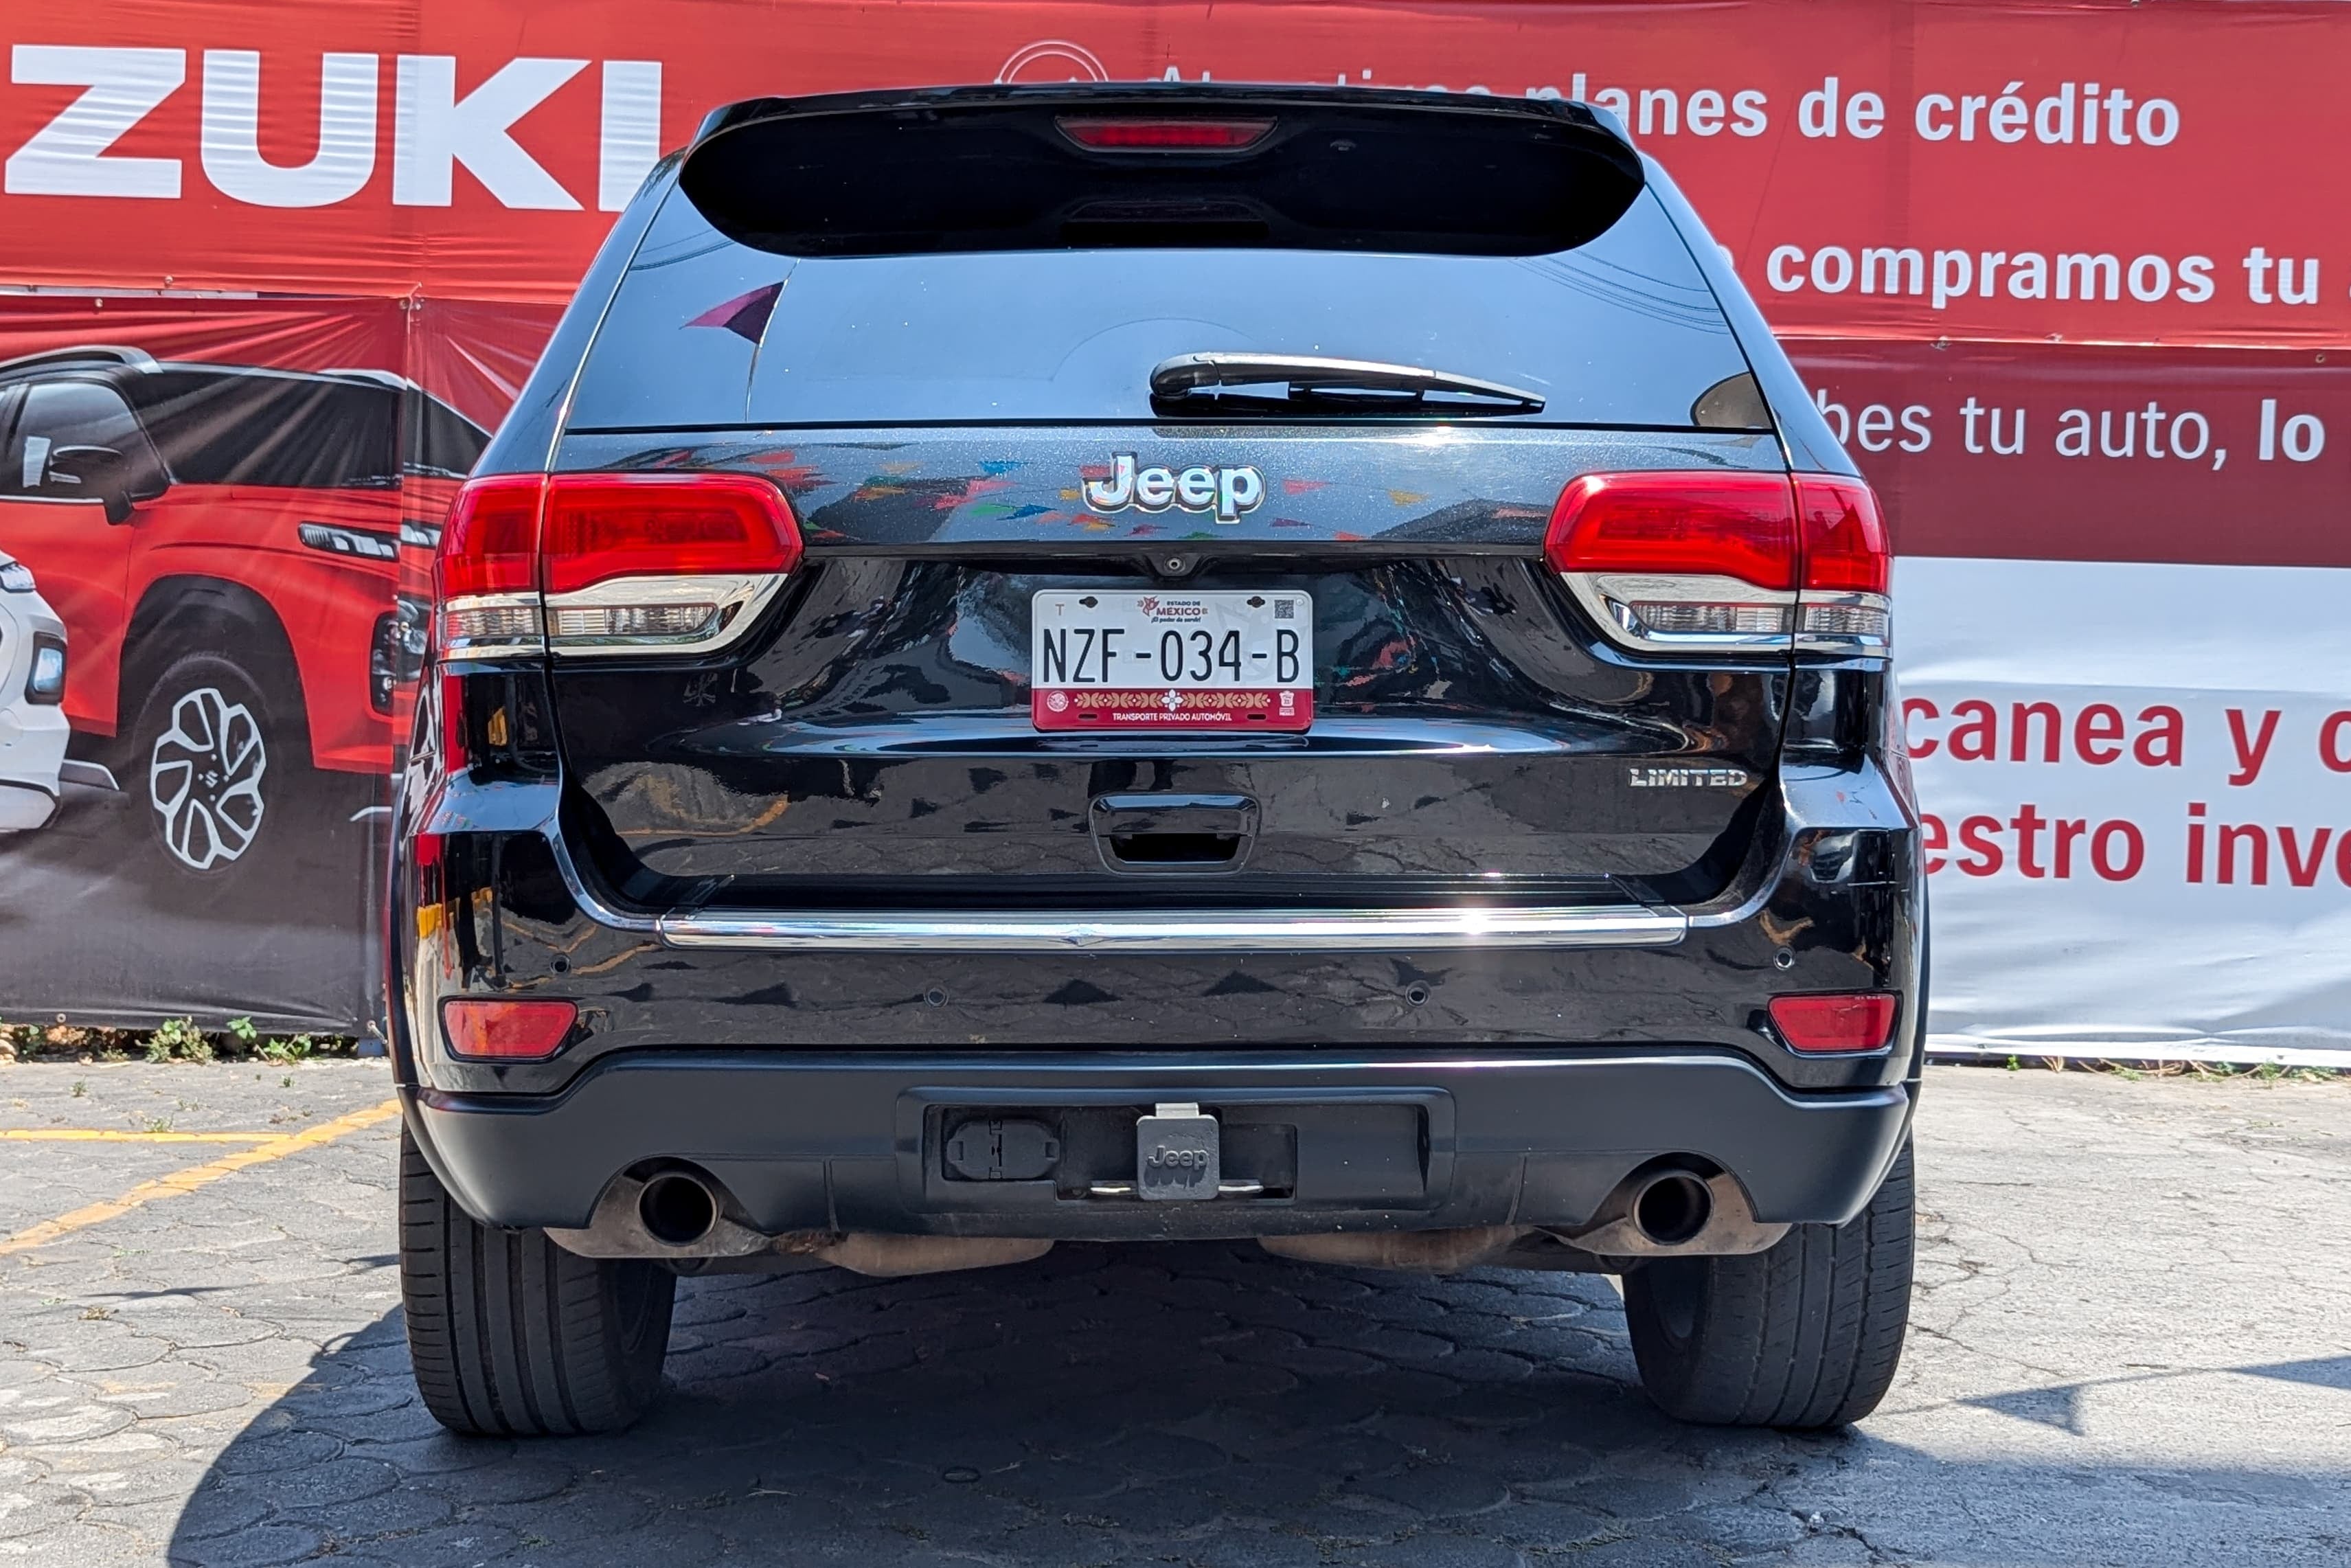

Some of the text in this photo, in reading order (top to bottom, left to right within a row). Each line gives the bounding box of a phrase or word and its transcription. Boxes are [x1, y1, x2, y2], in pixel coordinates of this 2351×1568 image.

[4, 45, 661, 212] ZUKI
[1525, 73, 1768, 137] lanes
[1798, 76, 1885, 139] de
[1915, 80, 2180, 146] crédito
[1767, 244, 2319, 309] compramos tu
[1960, 397, 2025, 455] tu
[2055, 401, 2227, 471] auto,
[2259, 398, 2326, 462] lo
[1082, 451, 1266, 524] Jeep
[1055, 604, 1065, 615] T
[1156, 607, 1201, 615] MÉXICO
[1043, 628, 1299, 683] NZF-034-B
[1113, 711, 1232, 721] TRANSPORTE PRIVADO AUTOMÓVIL
[1902, 697, 2183, 767] canea
[2225, 709, 2282, 786] y
[1629, 768, 1748, 787] LIMITED
[1920, 804, 2145, 882] estro
[1146, 1145, 1209, 1171] Jeep
